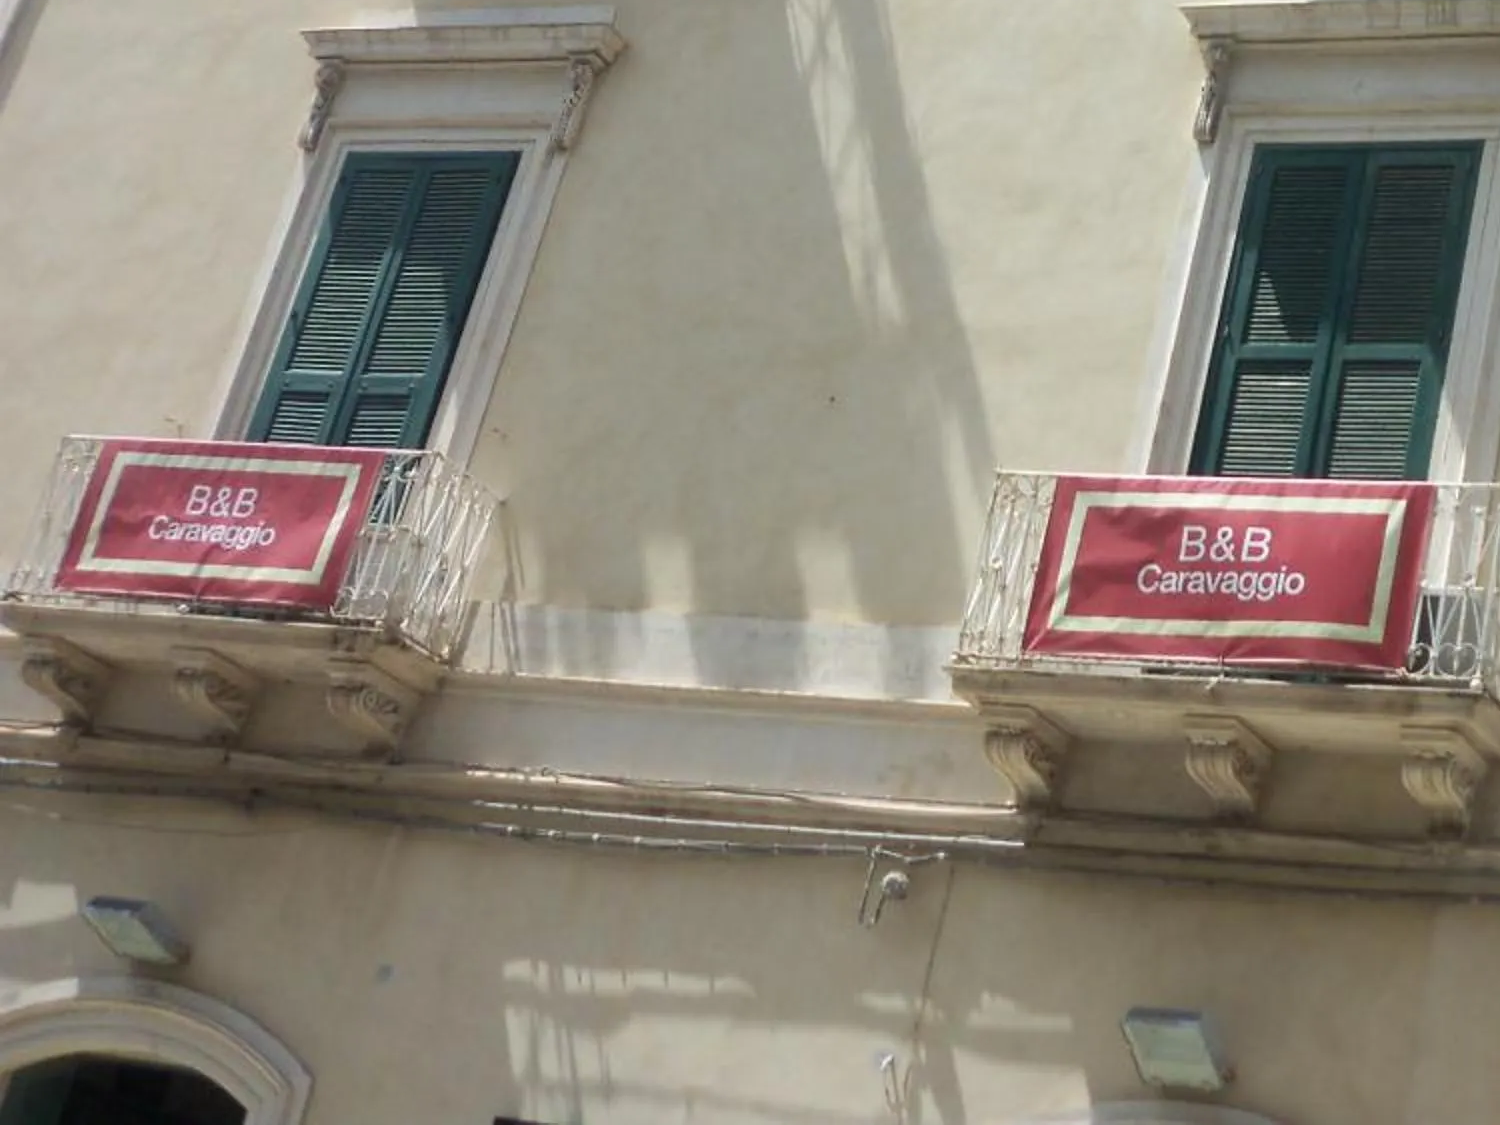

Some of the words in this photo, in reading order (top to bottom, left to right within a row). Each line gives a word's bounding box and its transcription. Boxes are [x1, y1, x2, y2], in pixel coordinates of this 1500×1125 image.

[186, 485, 258, 518] B&B
[148, 514, 276, 552] Caravaggio
[1179, 525, 1273, 563] B&B
[1136, 563, 1305, 602] Caravaggio
